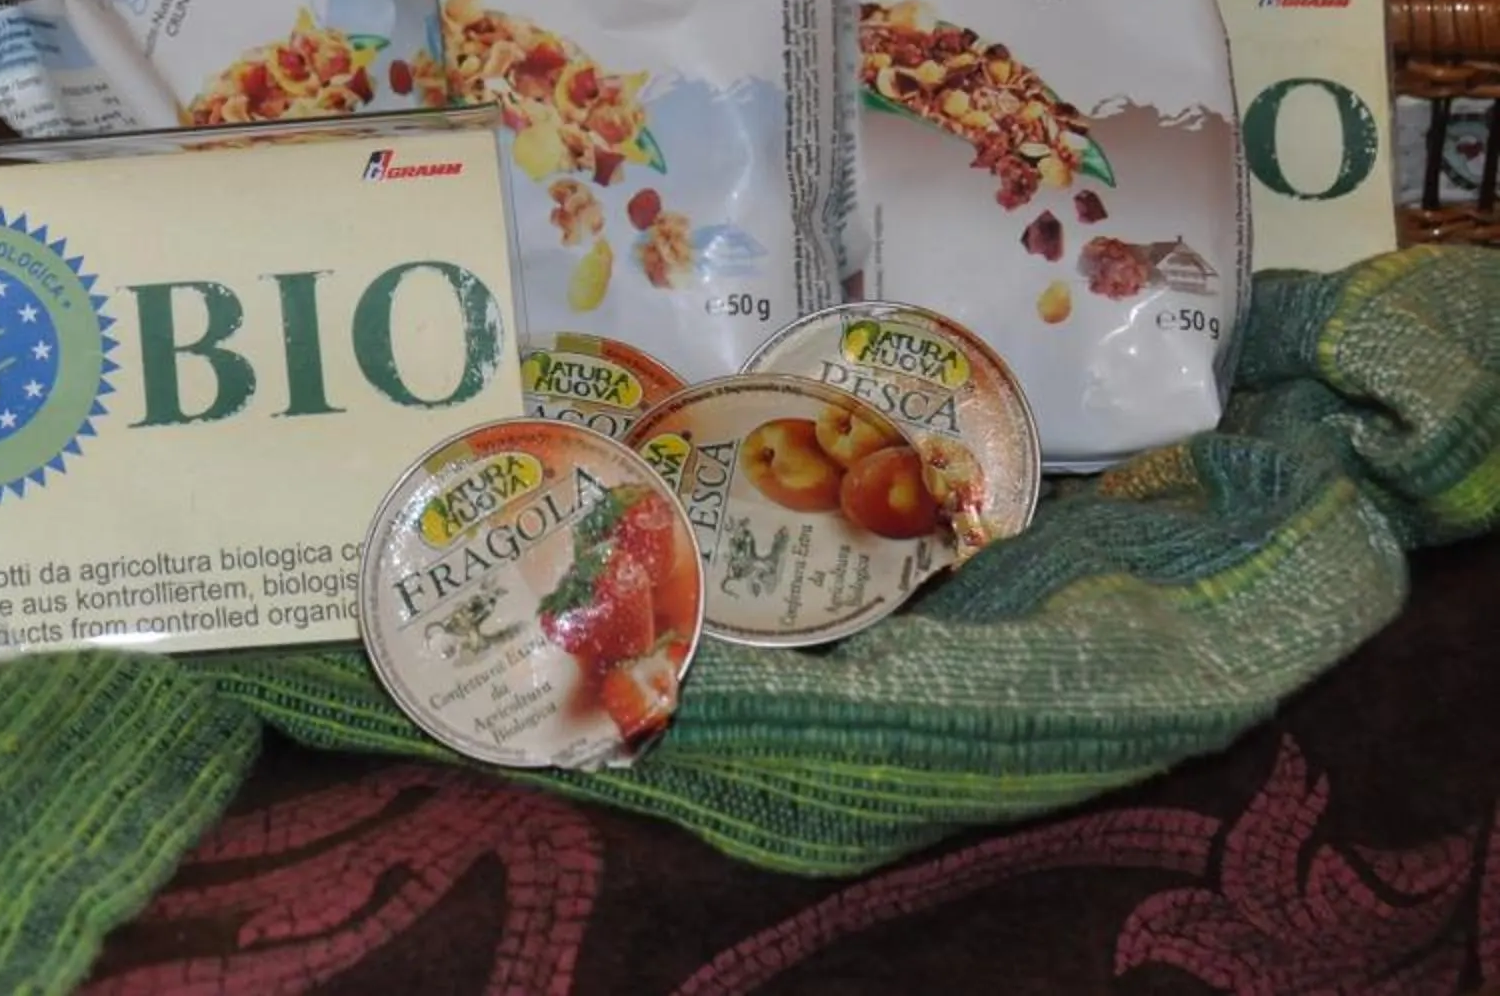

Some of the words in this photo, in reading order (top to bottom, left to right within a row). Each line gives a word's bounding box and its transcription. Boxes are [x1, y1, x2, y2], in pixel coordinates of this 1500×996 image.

[127, 259, 506, 429] BIO
[533, 375, 623, 404] NUOVA
[821, 360, 961, 433] PESCA
[442, 474, 529, 536] NUOVA
[689, 440, 736, 562] ESCA
[38, 560, 71, 585] da
[79, 552, 212, 586] agricoltura
[220, 541, 333, 571] biologica
[393, 466, 613, 617] FRAGOLA
[21, 594, 68, 616] aus
[75, 578, 255, 611] kontrolliertem,
[70, 616, 127, 640] from
[135, 604, 259, 634] controlled
[267, 596, 361, 630] organic
